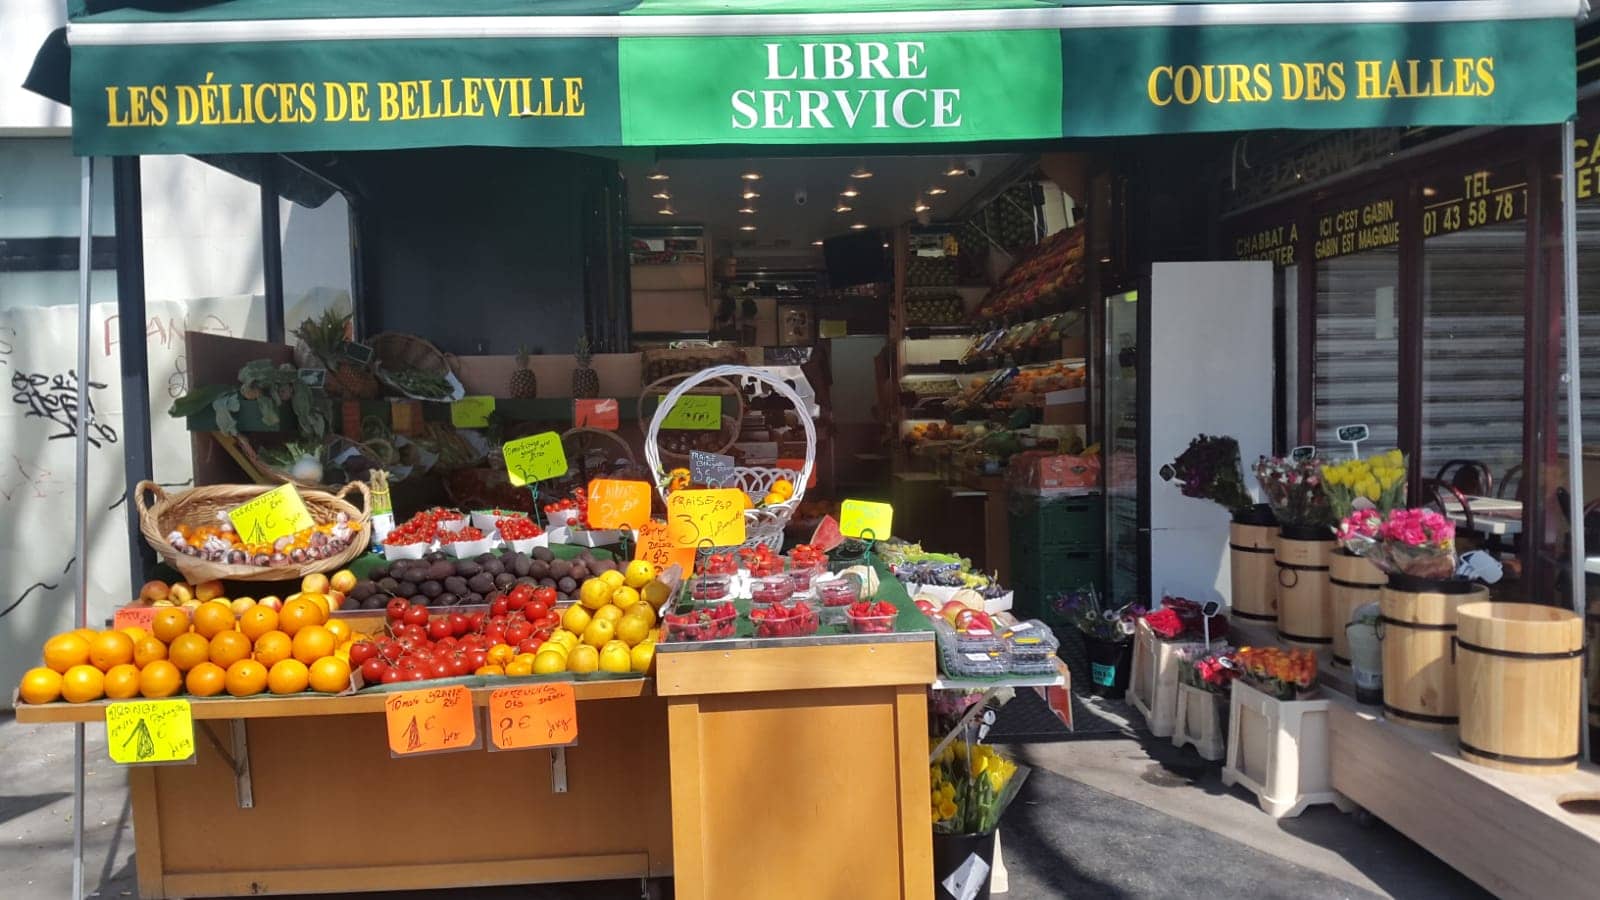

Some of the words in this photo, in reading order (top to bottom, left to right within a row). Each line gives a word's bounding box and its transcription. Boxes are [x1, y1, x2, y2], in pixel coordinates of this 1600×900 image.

[763, 40, 929, 81] LIBRE
[1147, 62, 1273, 106] COURS
[1280, 60, 1347, 101] DES
[1355, 55, 1495, 99] HALLES
[105, 84, 168, 127] LES
[175, 72, 318, 125] DÉLICES
[323, 81, 371, 123] DE
[377, 77, 586, 122] BELLEVILLE
[730, 88, 963, 130] SERVICE
[1464, 171, 1491, 200] TEL
[1362, 199, 1394, 224] GABIN
[1423, 210, 1437, 235] 01
[1443, 204, 1461, 231] 43
[1468, 199, 1487, 226] 58
[1495, 192, 1513, 221] 78
[1342, 232, 1356, 253] EST
[1358, 222, 1399, 250] MAGIQUE
[590, 484, 600, 504] 4
